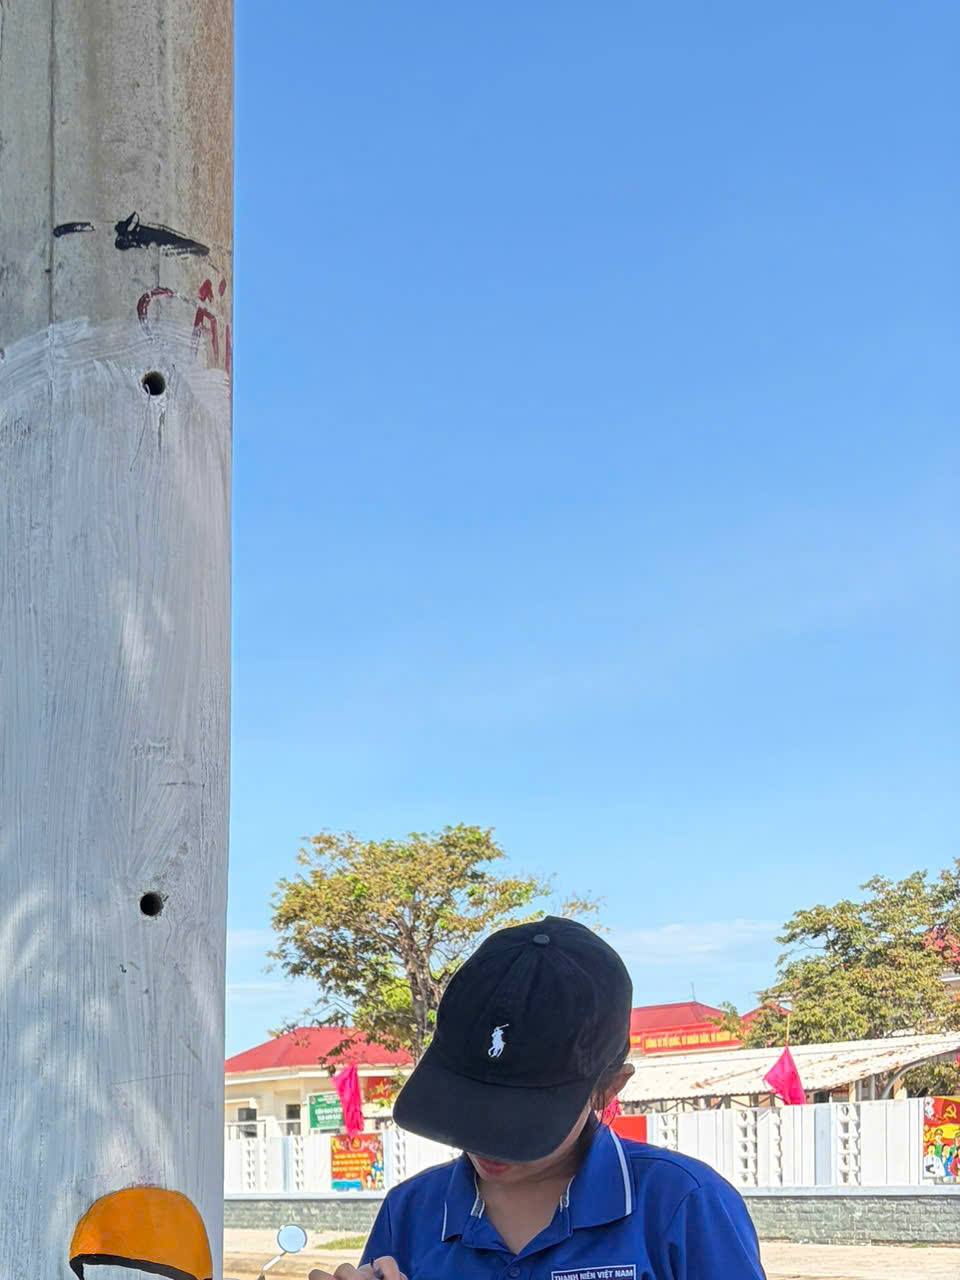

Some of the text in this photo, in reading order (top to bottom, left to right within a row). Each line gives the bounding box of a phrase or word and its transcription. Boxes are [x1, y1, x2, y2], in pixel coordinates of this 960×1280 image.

[580, 1271, 595, 1280] NIÊN
[597, 1270, 613, 1280] VIỆT
[615, 1269, 634, 1277] NAM
